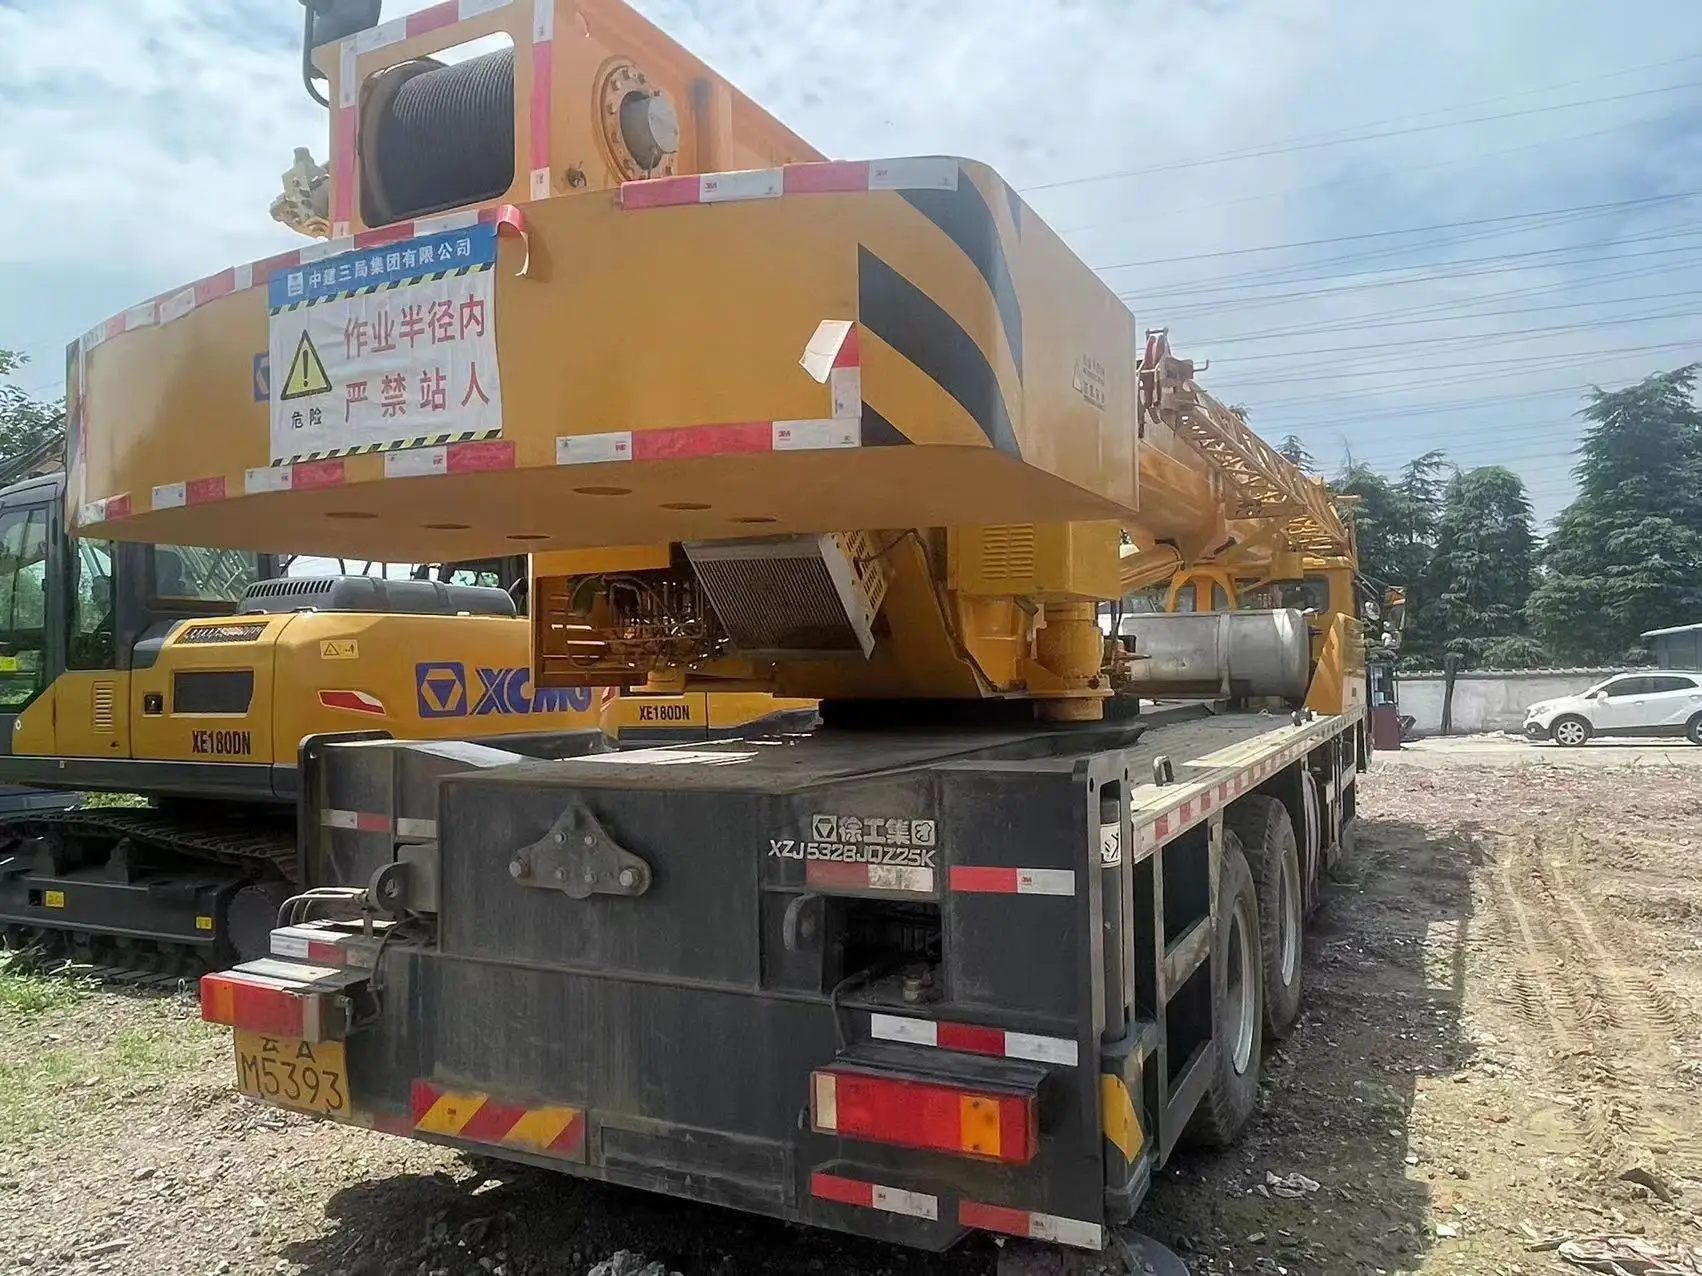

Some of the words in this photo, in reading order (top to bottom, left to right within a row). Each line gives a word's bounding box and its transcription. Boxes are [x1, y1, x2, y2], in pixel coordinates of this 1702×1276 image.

[307, 237, 471, 290] 中建三局集团有限公司
[344, 293, 485, 361] 作业半径内
[290, 407, 323, 430] 危险
[343, 361, 490, 423] 严禁站人
[639, 704, 690, 721] XE180DN
[191, 730, 251, 755] XE180DN
[240, 1051, 343, 1110] M5393
